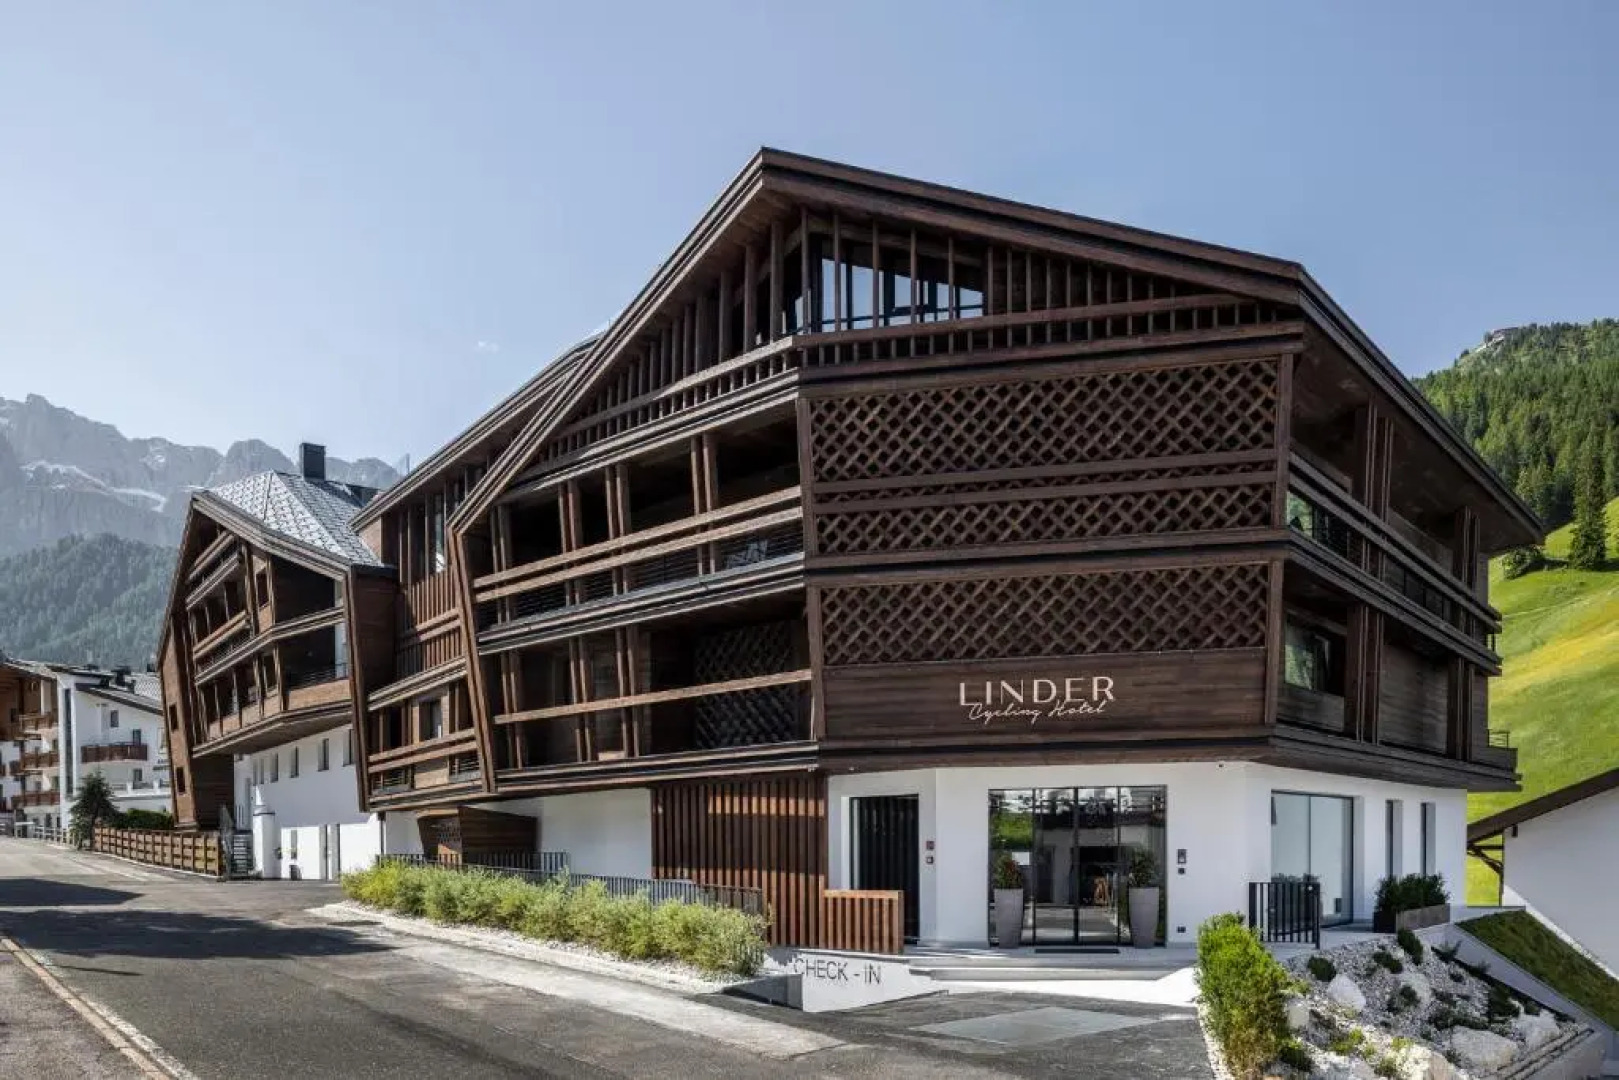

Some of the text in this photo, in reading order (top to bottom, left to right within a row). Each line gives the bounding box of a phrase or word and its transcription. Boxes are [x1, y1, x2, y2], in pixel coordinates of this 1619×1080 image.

[959, 676, 1114, 706] LINDER
[969, 698, 1108, 725] Cycling Hotel
[793, 958, 848, 981] CHECK
[864, 962, 882, 984] IN
